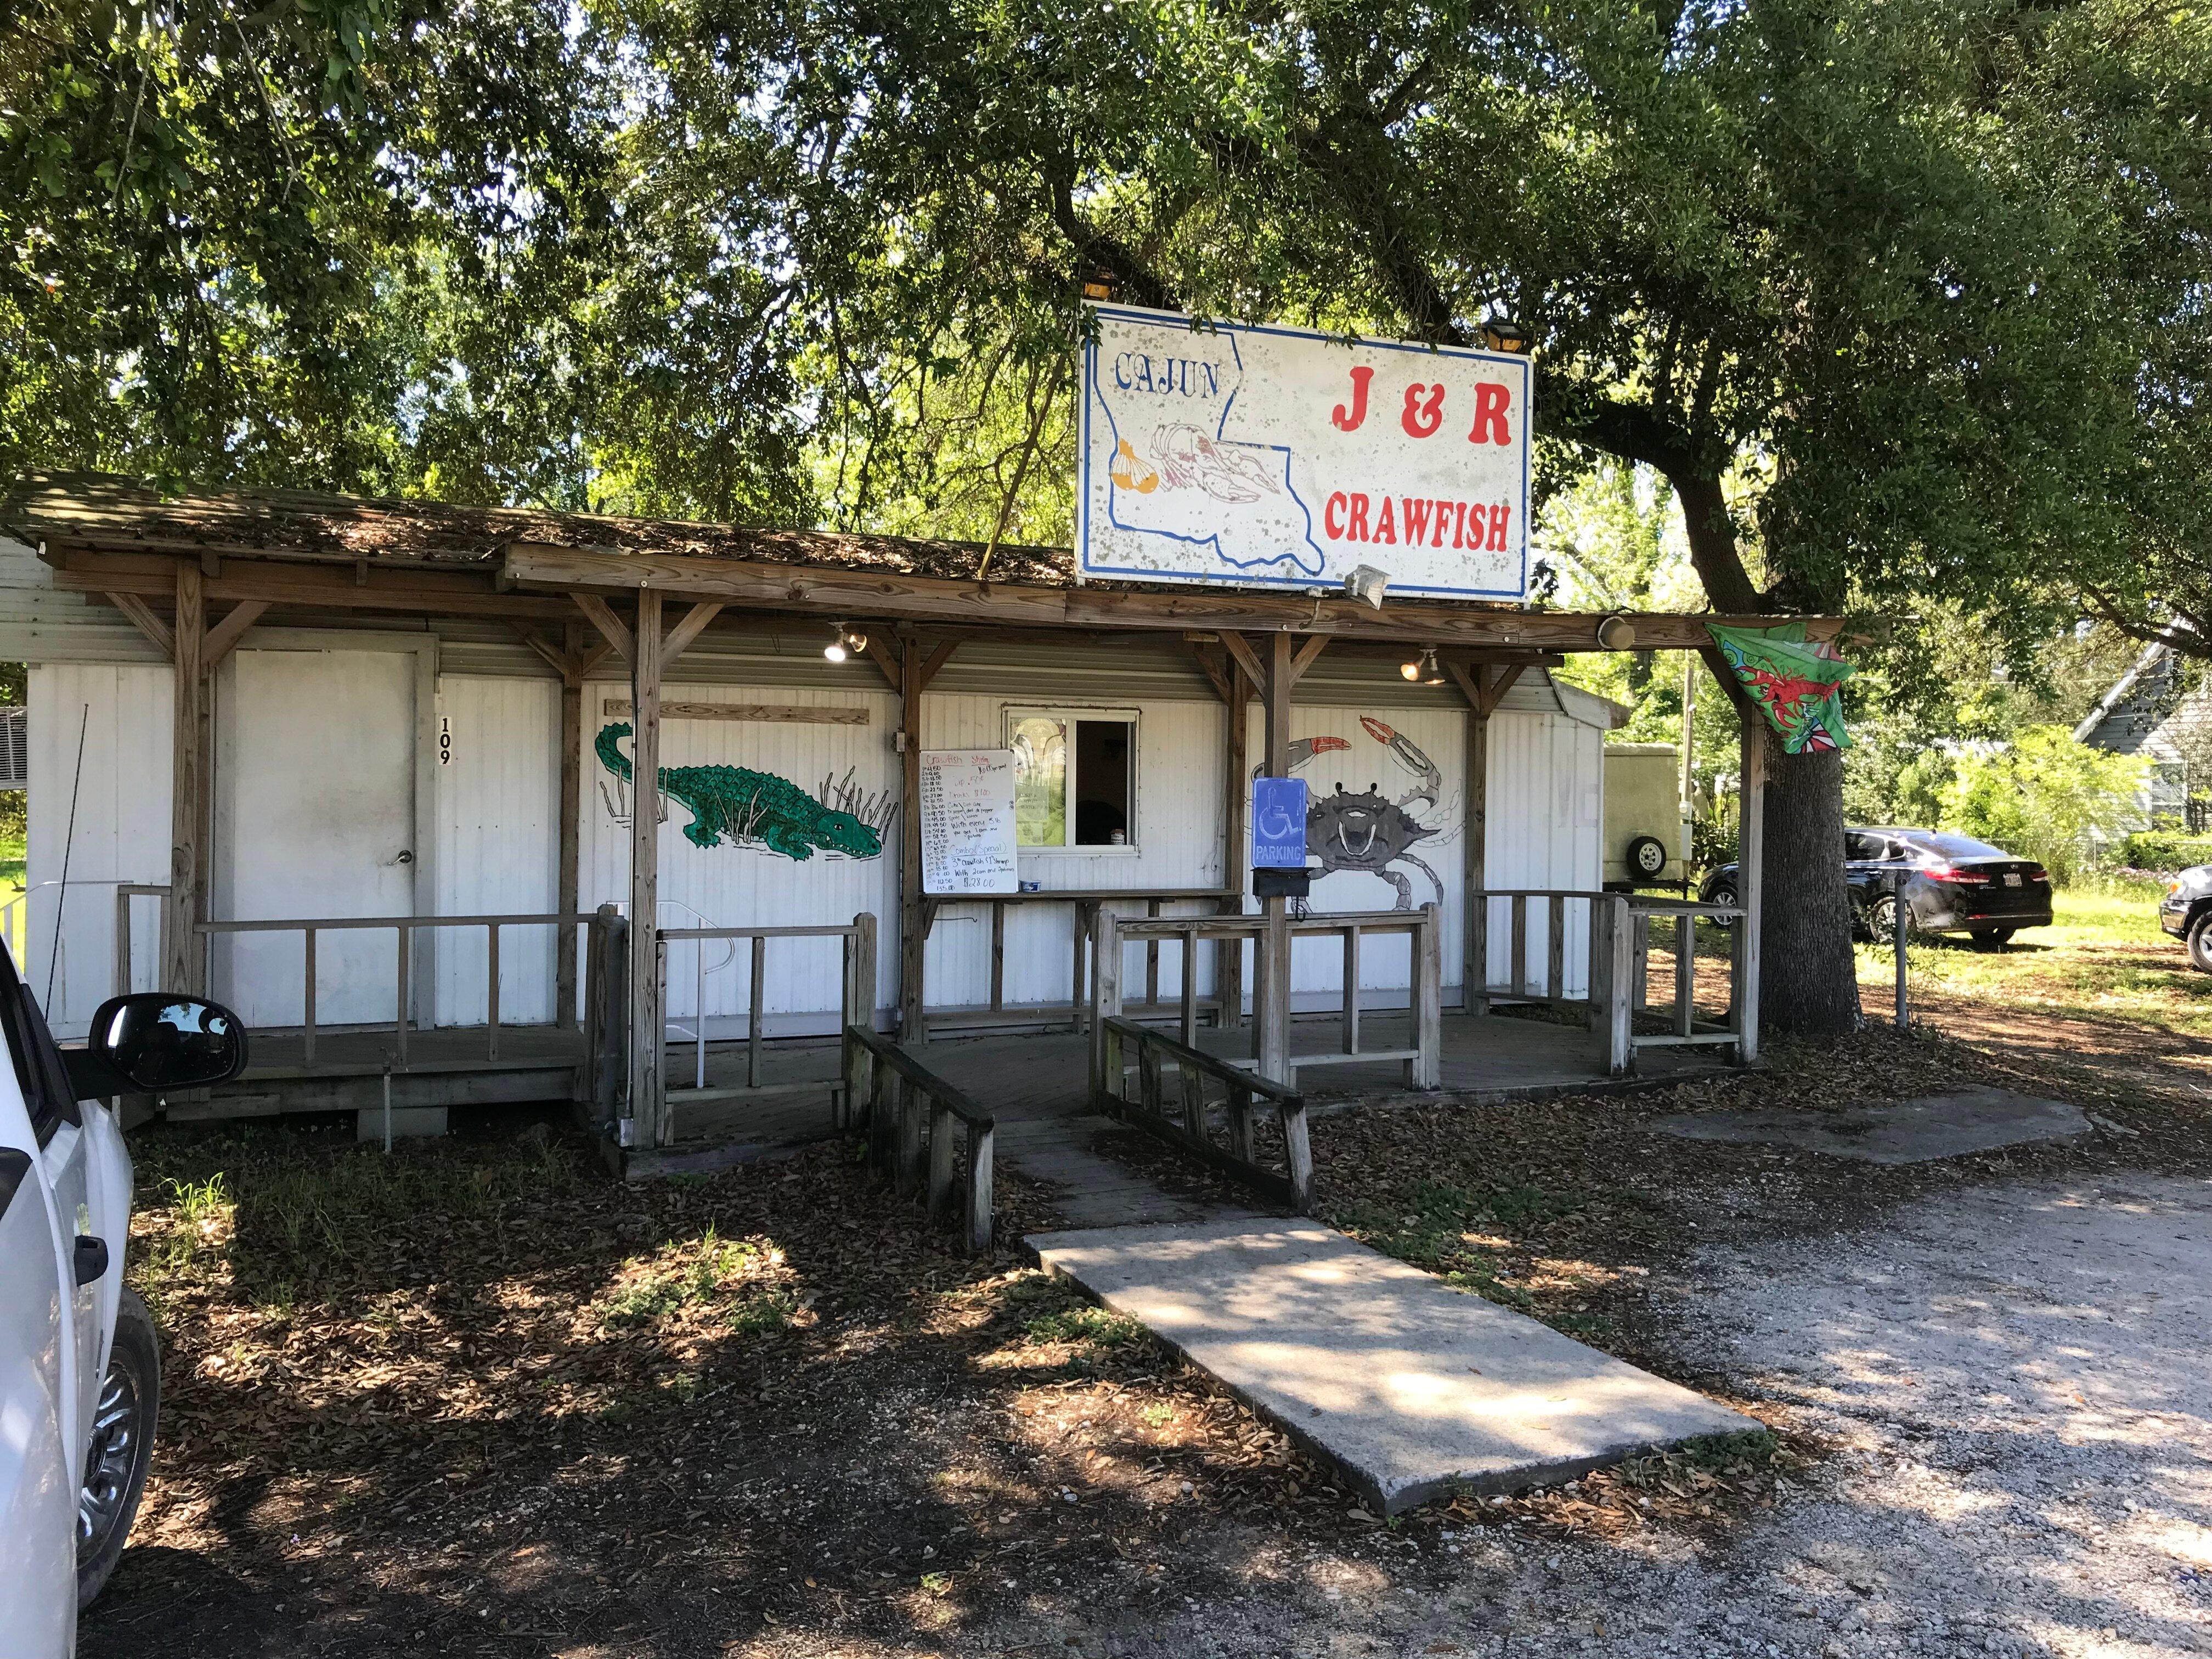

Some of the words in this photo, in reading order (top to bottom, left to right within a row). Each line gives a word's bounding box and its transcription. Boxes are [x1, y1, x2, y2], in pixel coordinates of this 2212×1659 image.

[1115, 352, 1220, 399] CAJUN
[1332, 366, 1374, 432] J
[1401, 382, 1445, 438] &
[1468, 382, 1512, 446] R
[1324, 491, 1510, 552] CRAWFISH
[439, 717, 451, 765] 109
[926, 754, 963, 766] Crawfish
[951, 821, 967, 829] With
[1256, 845, 1301, 861] PARKING
[955, 869, 969, 877] With
